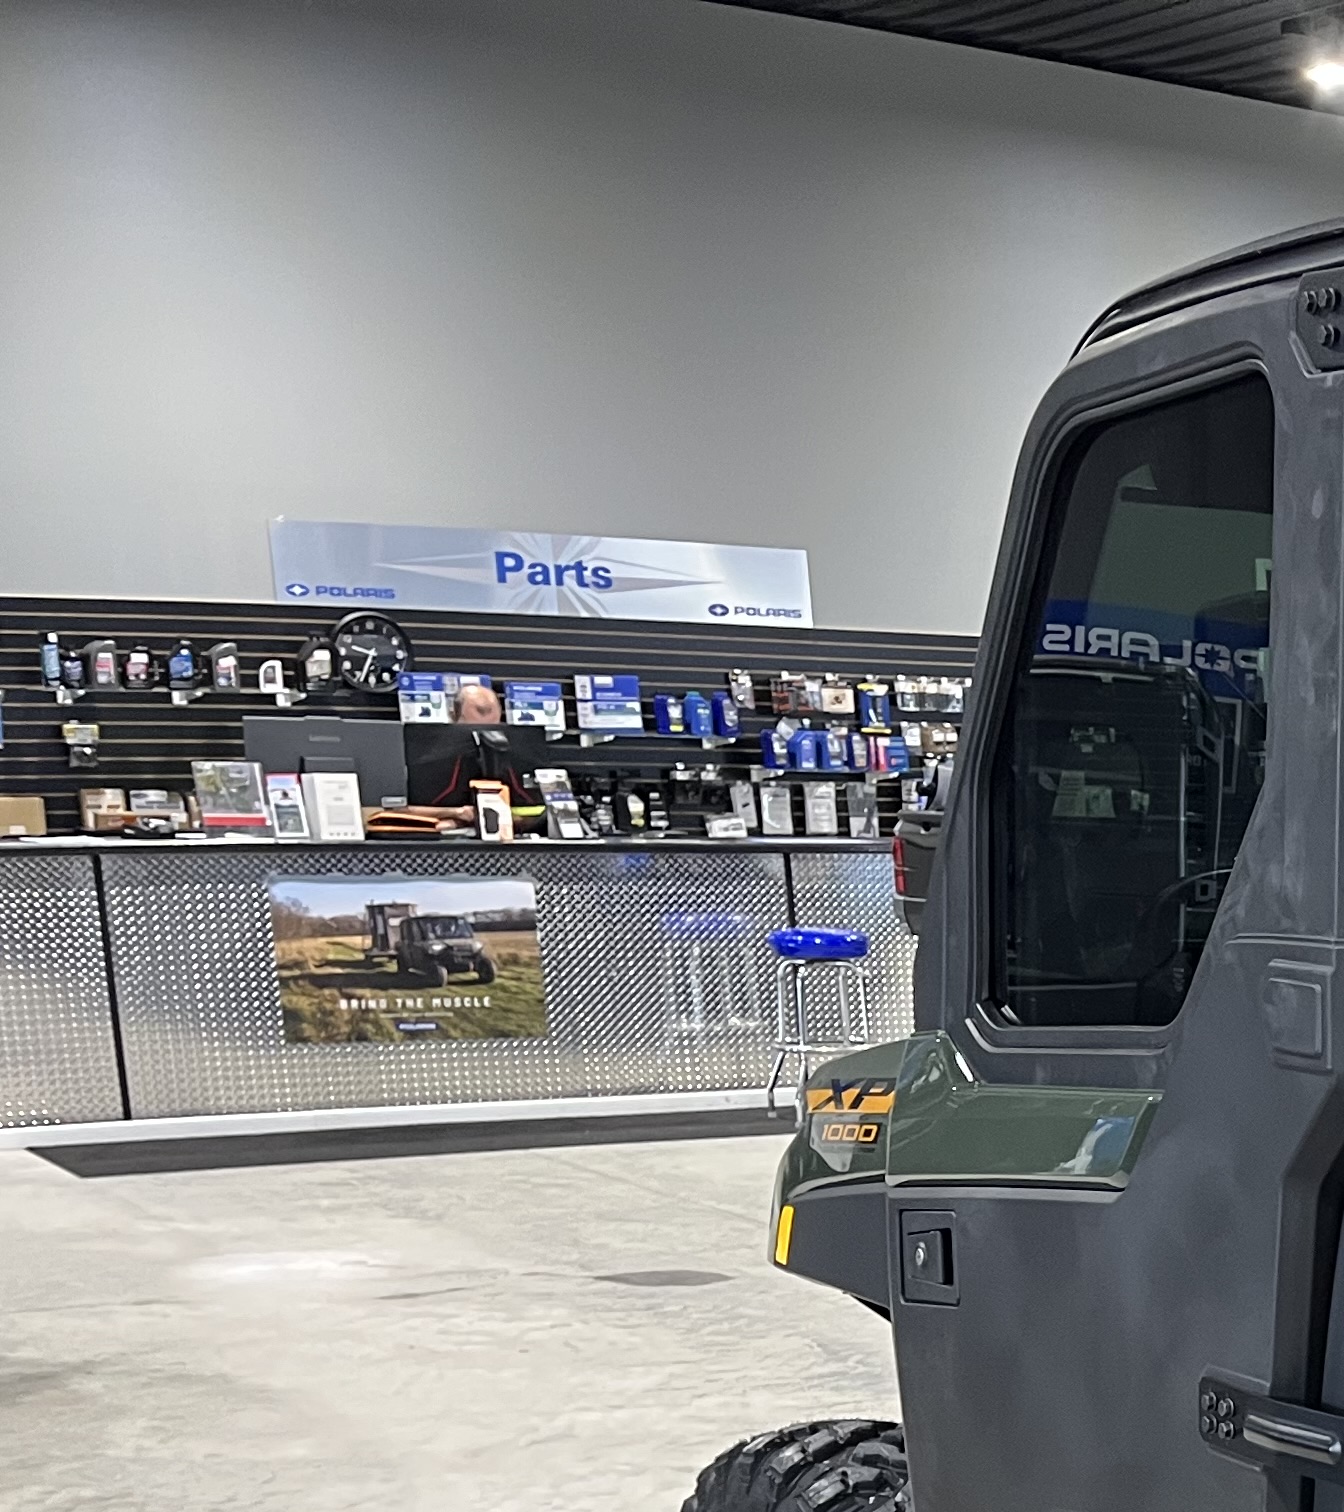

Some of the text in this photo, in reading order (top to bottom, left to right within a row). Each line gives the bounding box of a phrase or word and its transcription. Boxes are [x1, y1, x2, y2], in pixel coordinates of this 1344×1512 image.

[494, 550, 614, 589] Parts
[314, 585, 395, 600] POLARIS
[734, 605, 803, 619] POLARIS
[340, 996, 492, 1010] BRING THE MUSCLE
[812, 1077, 897, 1111] XP
[821, 1122, 879, 1143] 1000
